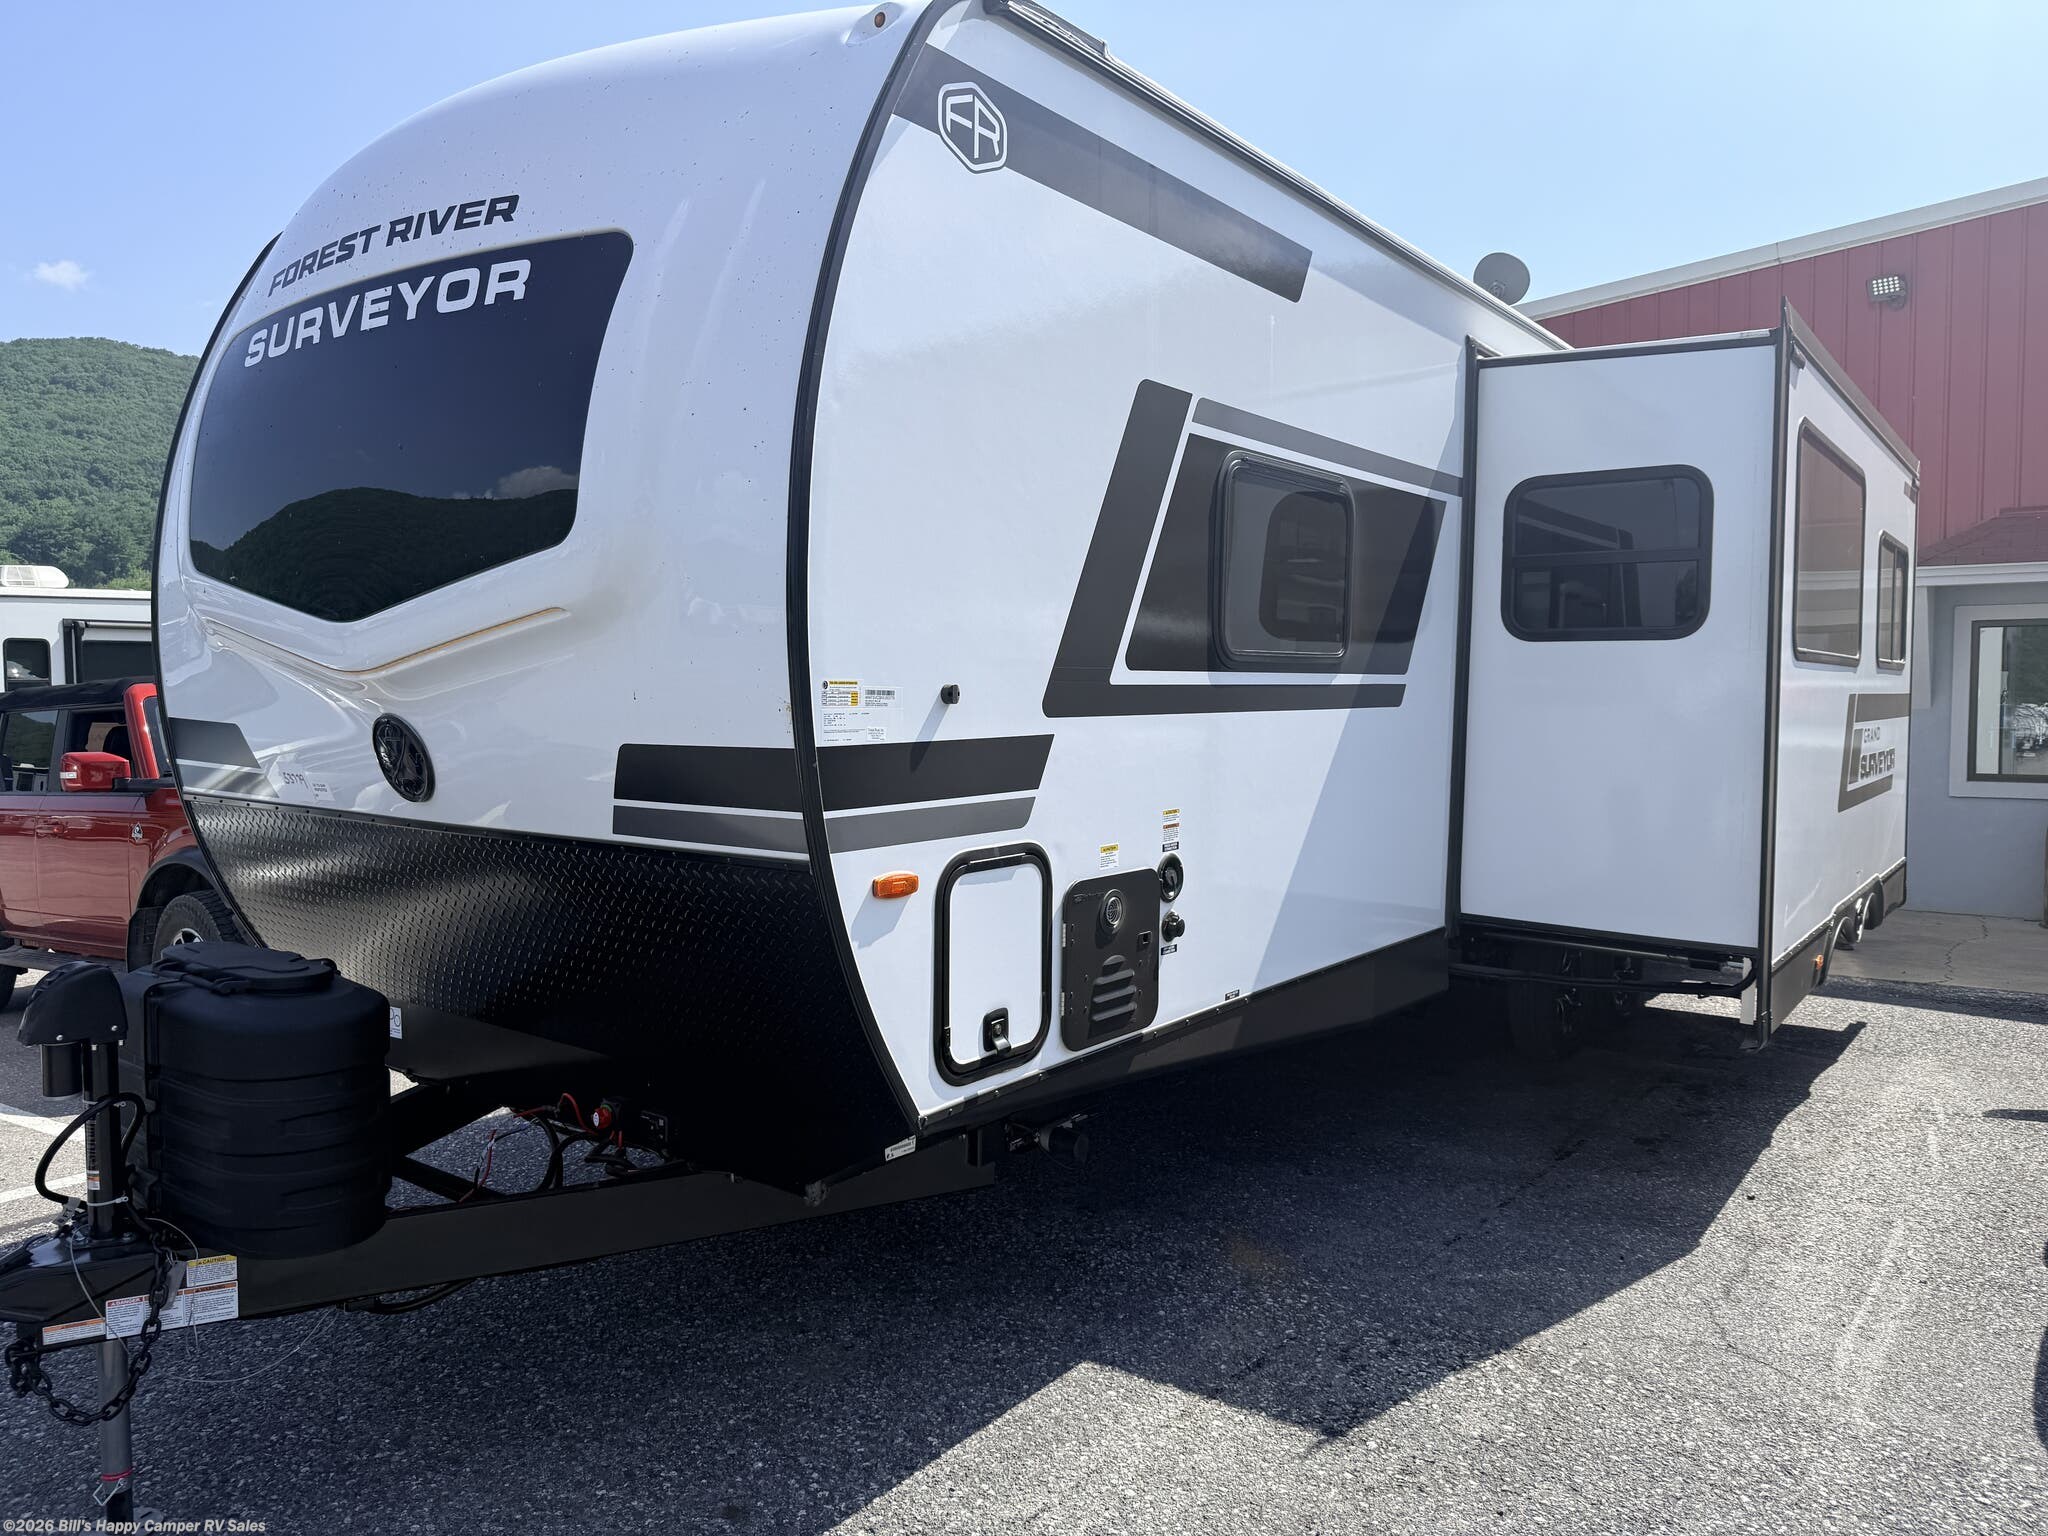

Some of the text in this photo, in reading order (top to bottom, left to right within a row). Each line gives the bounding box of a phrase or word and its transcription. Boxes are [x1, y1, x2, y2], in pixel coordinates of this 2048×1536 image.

[267, 194, 519, 297] FOREST RIVER
[244, 259, 531, 367] SURVEYOR
[1861, 748, 1895, 779] SURVEYOR
